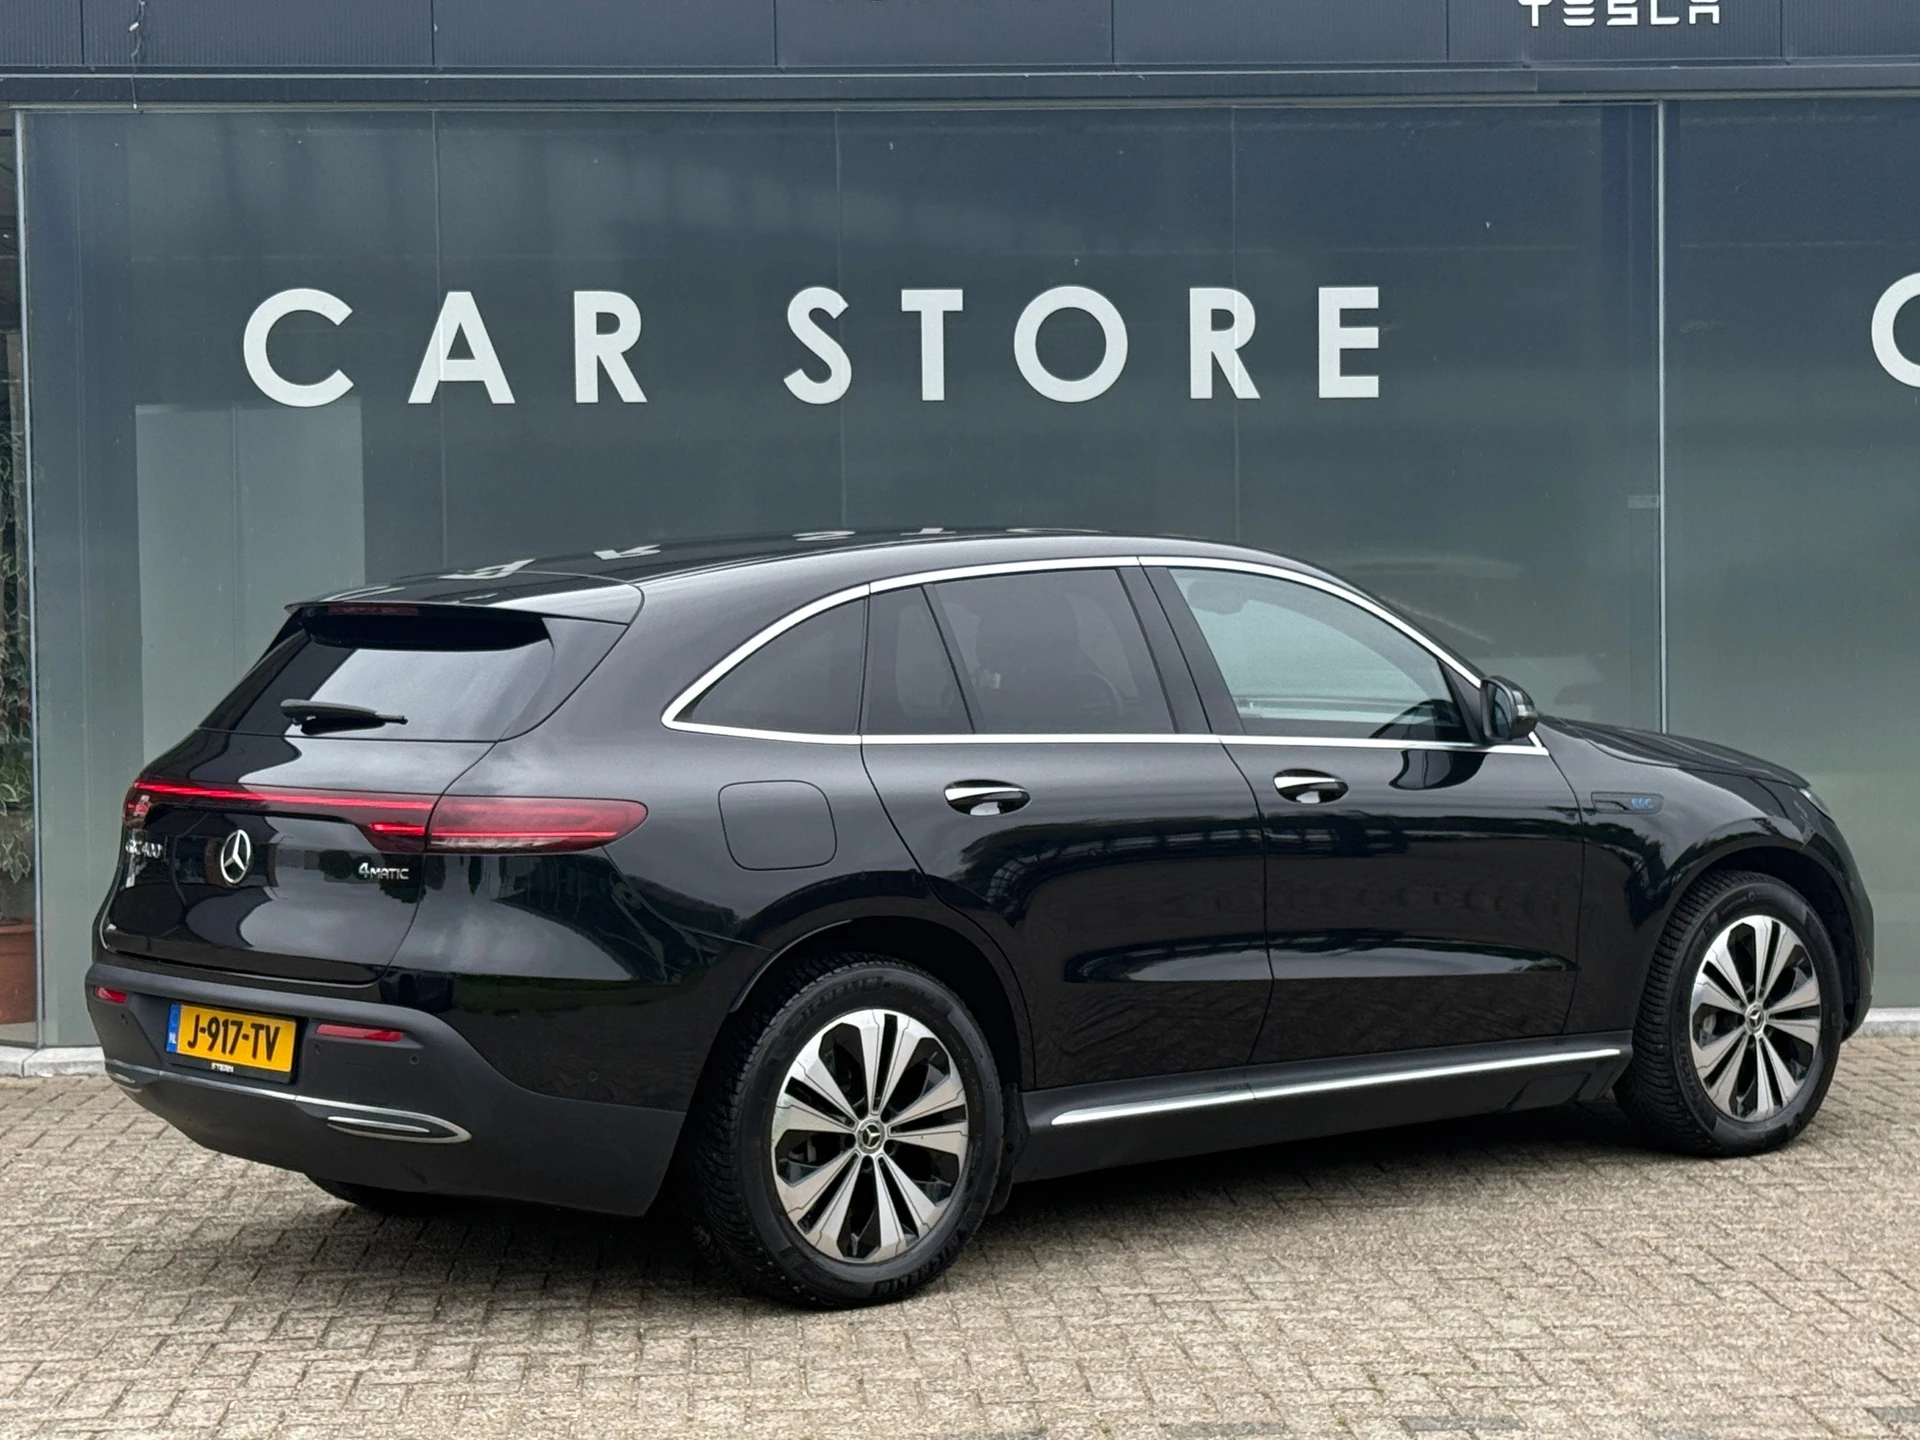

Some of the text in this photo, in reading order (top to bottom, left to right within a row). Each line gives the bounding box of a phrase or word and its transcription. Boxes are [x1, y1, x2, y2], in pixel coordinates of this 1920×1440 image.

[1518, 0, 1719, 26] TESLA
[244, 286, 1378, 407] CAR STORE
[358, 862, 410, 880] 4MATIC
[187, 1013, 281, 1062] J-917-TV
